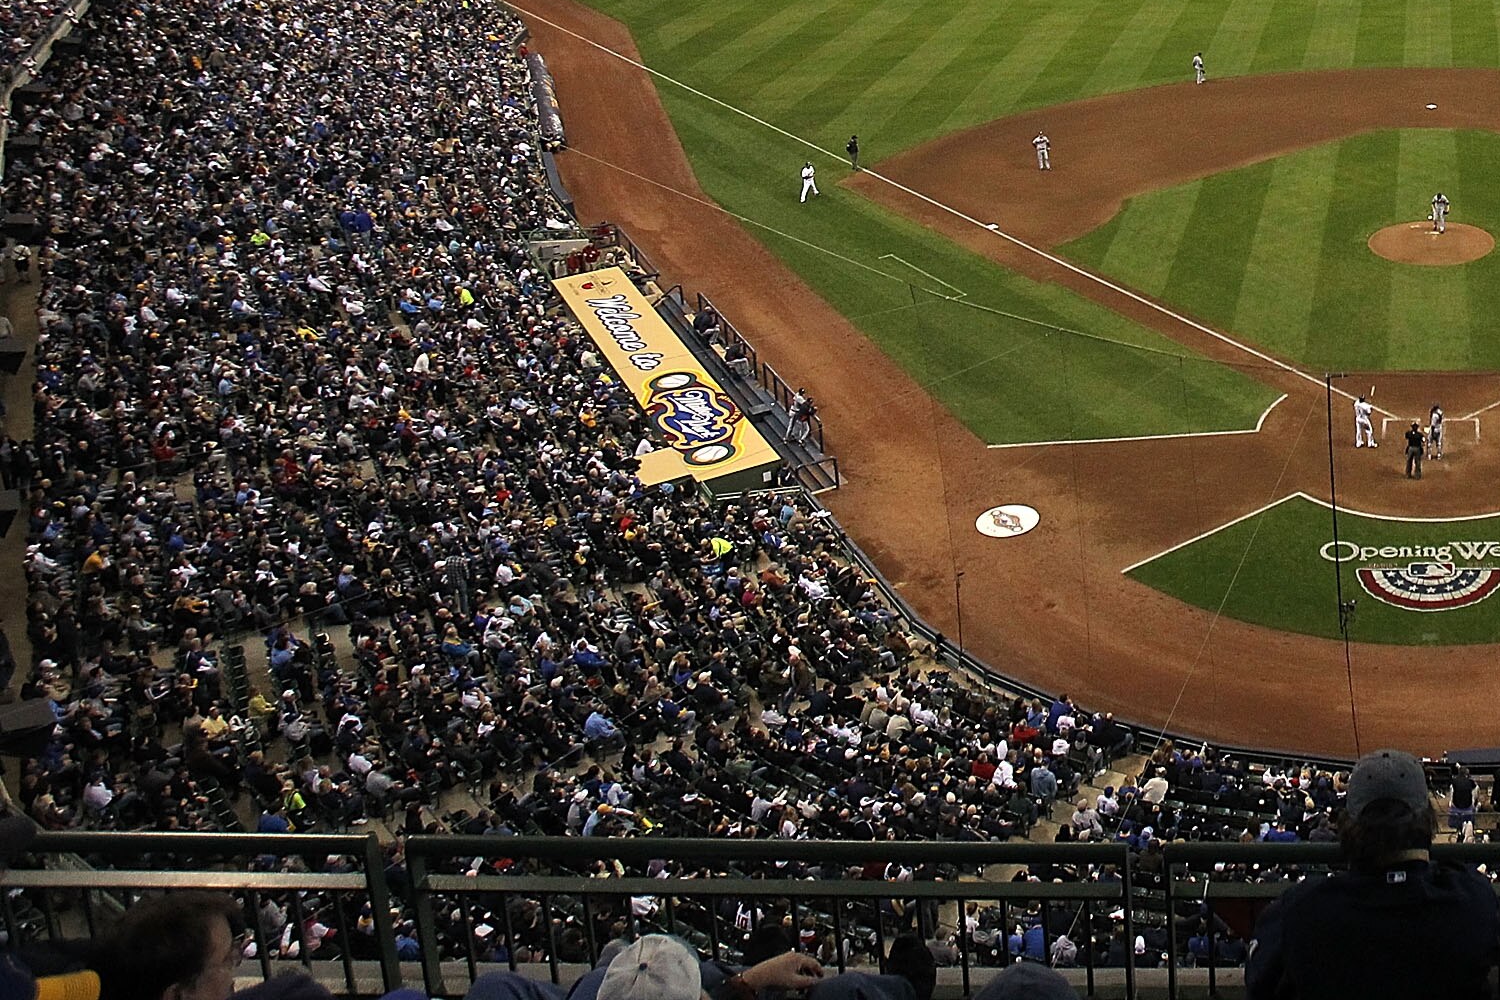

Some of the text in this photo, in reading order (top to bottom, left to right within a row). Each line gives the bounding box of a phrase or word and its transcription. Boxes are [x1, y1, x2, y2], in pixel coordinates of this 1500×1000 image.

[586, 294, 663, 370] Welcome to
[1320, 541, 1453, 562] Opening
